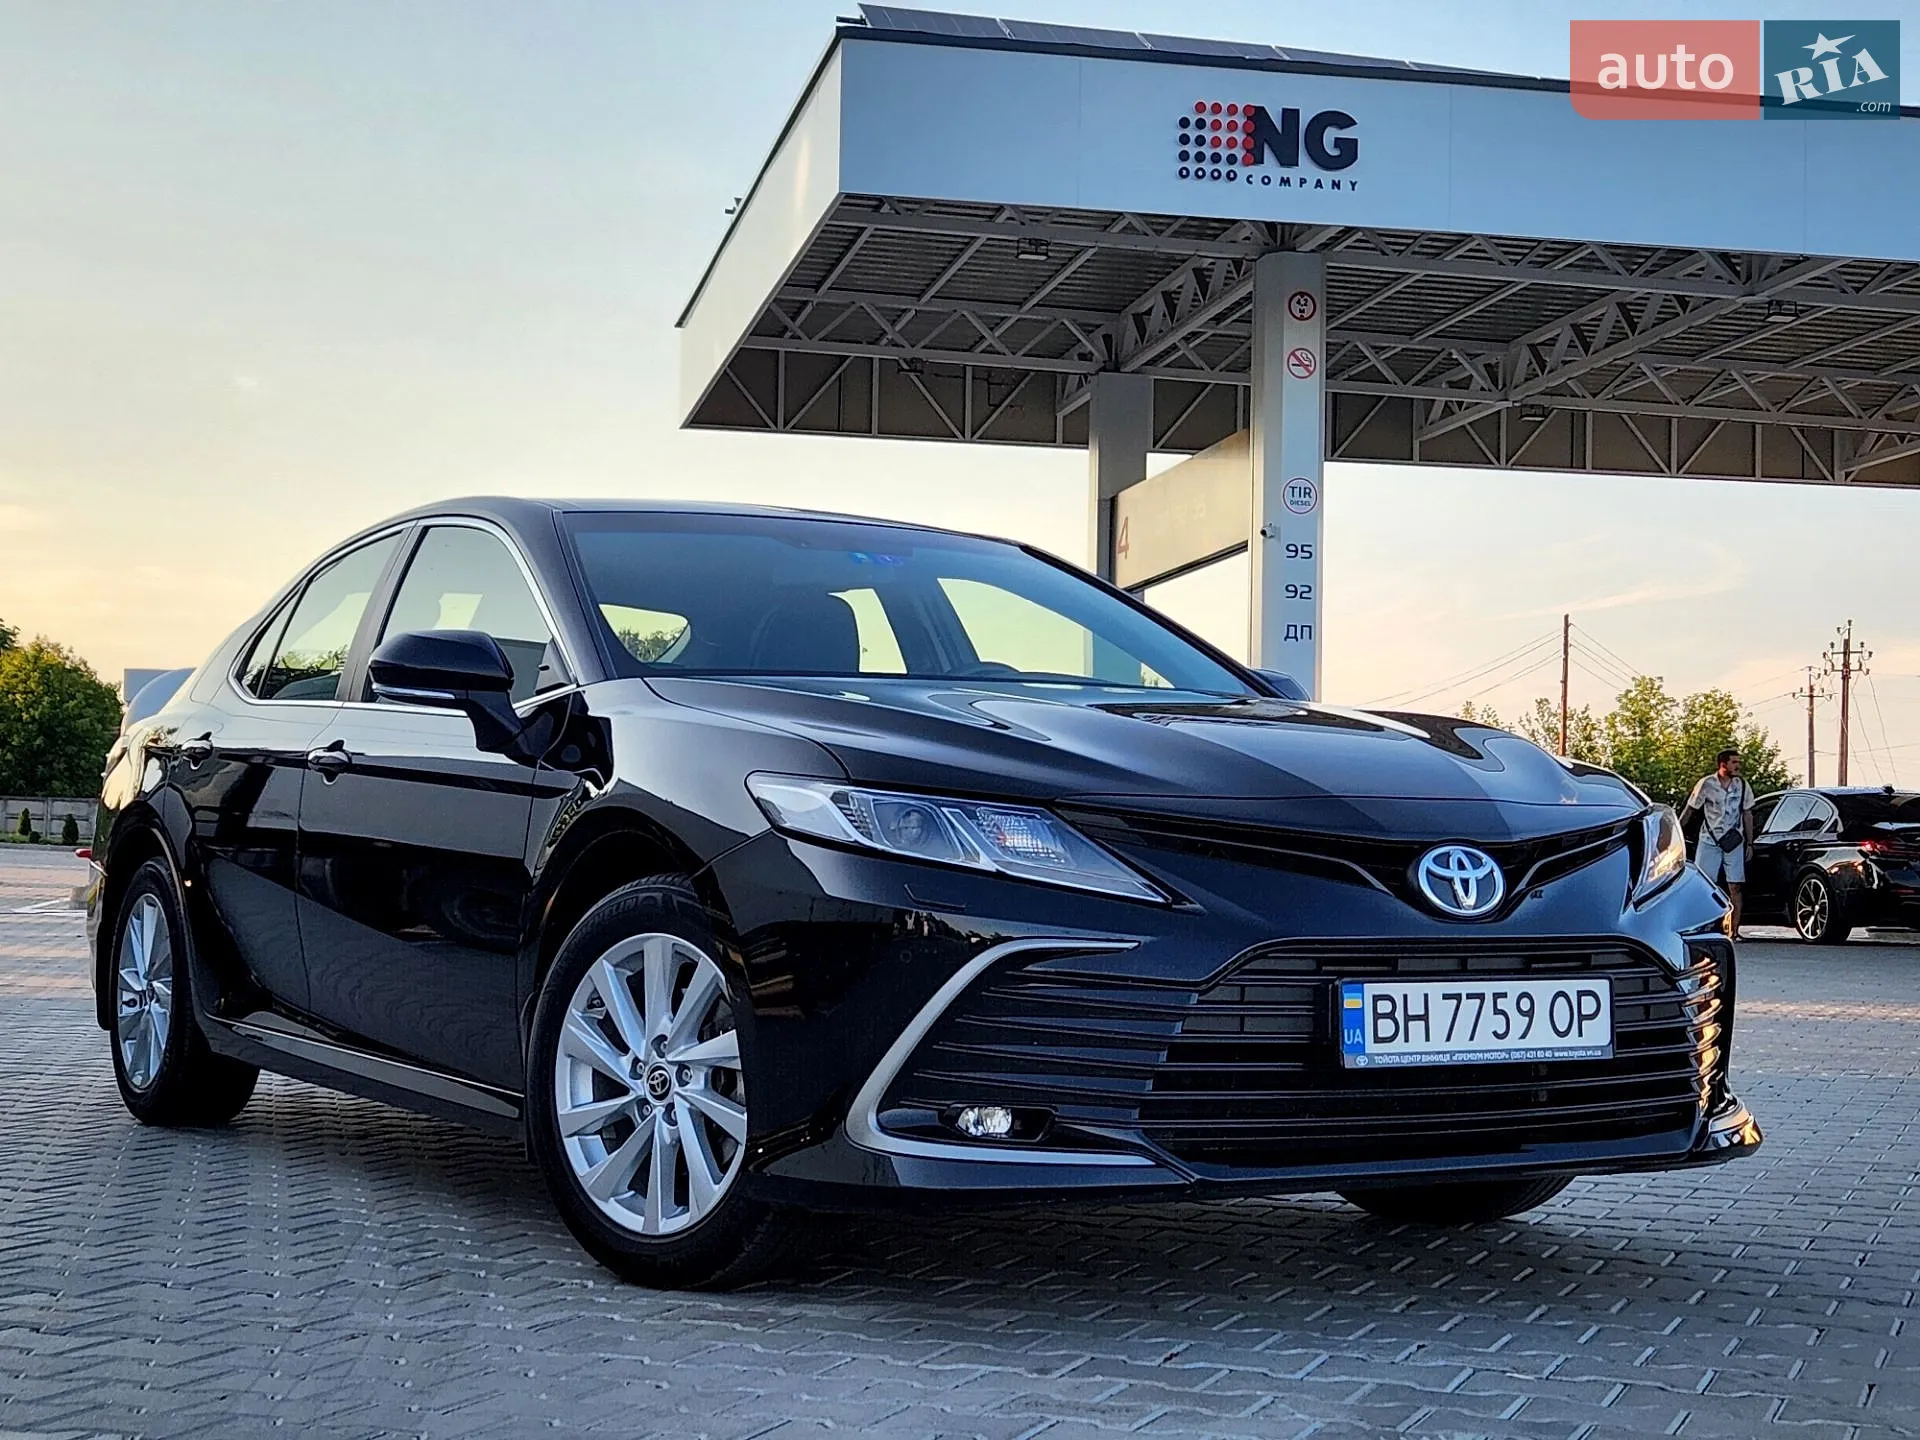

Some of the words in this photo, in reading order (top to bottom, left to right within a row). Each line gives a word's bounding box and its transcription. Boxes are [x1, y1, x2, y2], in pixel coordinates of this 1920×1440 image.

[1246, 104, 1359, 171] NG
[1245, 173, 1358, 192] COMPANY
[1288, 485, 1312, 499] TIR
[1289, 499, 1312, 507] DIESEL
[1116, 515, 1129, 560] 4
[1285, 543, 1313, 560] 95
[1284, 584, 1312, 600] 92
[1284, 624, 1312, 642] ДП
[1371, 992, 1431, 1044] BH
[1441, 991, 1536, 1043] 7759
[1344, 1027, 1364, 1045] UA
[1374, 1054, 1400, 1064] ТОЙОТА
[1400, 1054, 1421, 1064] ЦЕНТР
